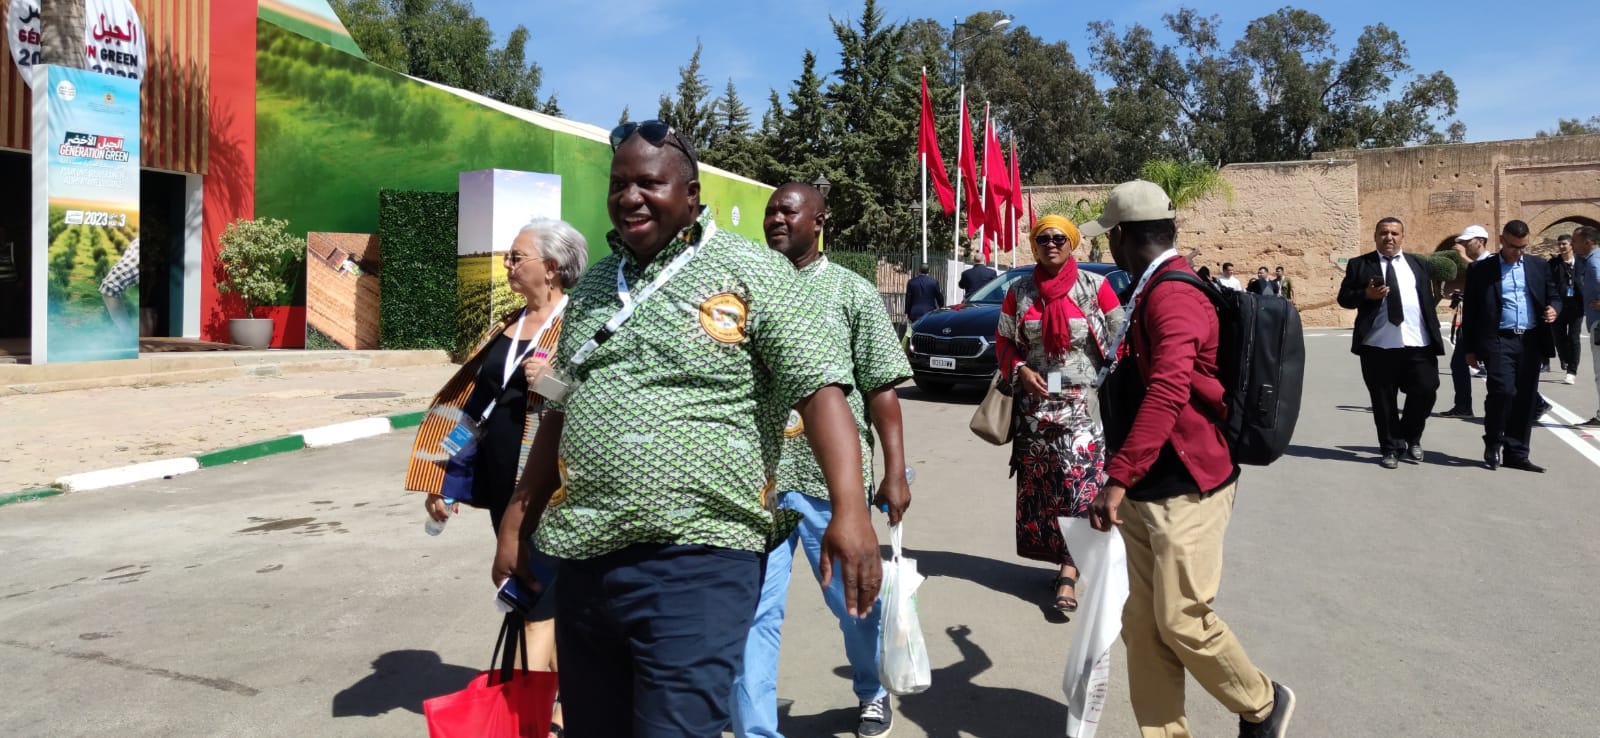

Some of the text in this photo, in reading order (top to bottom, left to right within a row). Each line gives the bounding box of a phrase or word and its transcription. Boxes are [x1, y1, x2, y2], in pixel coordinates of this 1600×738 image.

[93, 12, 137, 47] الجيل
[100, 48, 138, 67] GREEN
[98, 137, 123, 150] الجيل
[105, 150, 129, 162] GREEN
[83, 211, 108, 226] 2023
